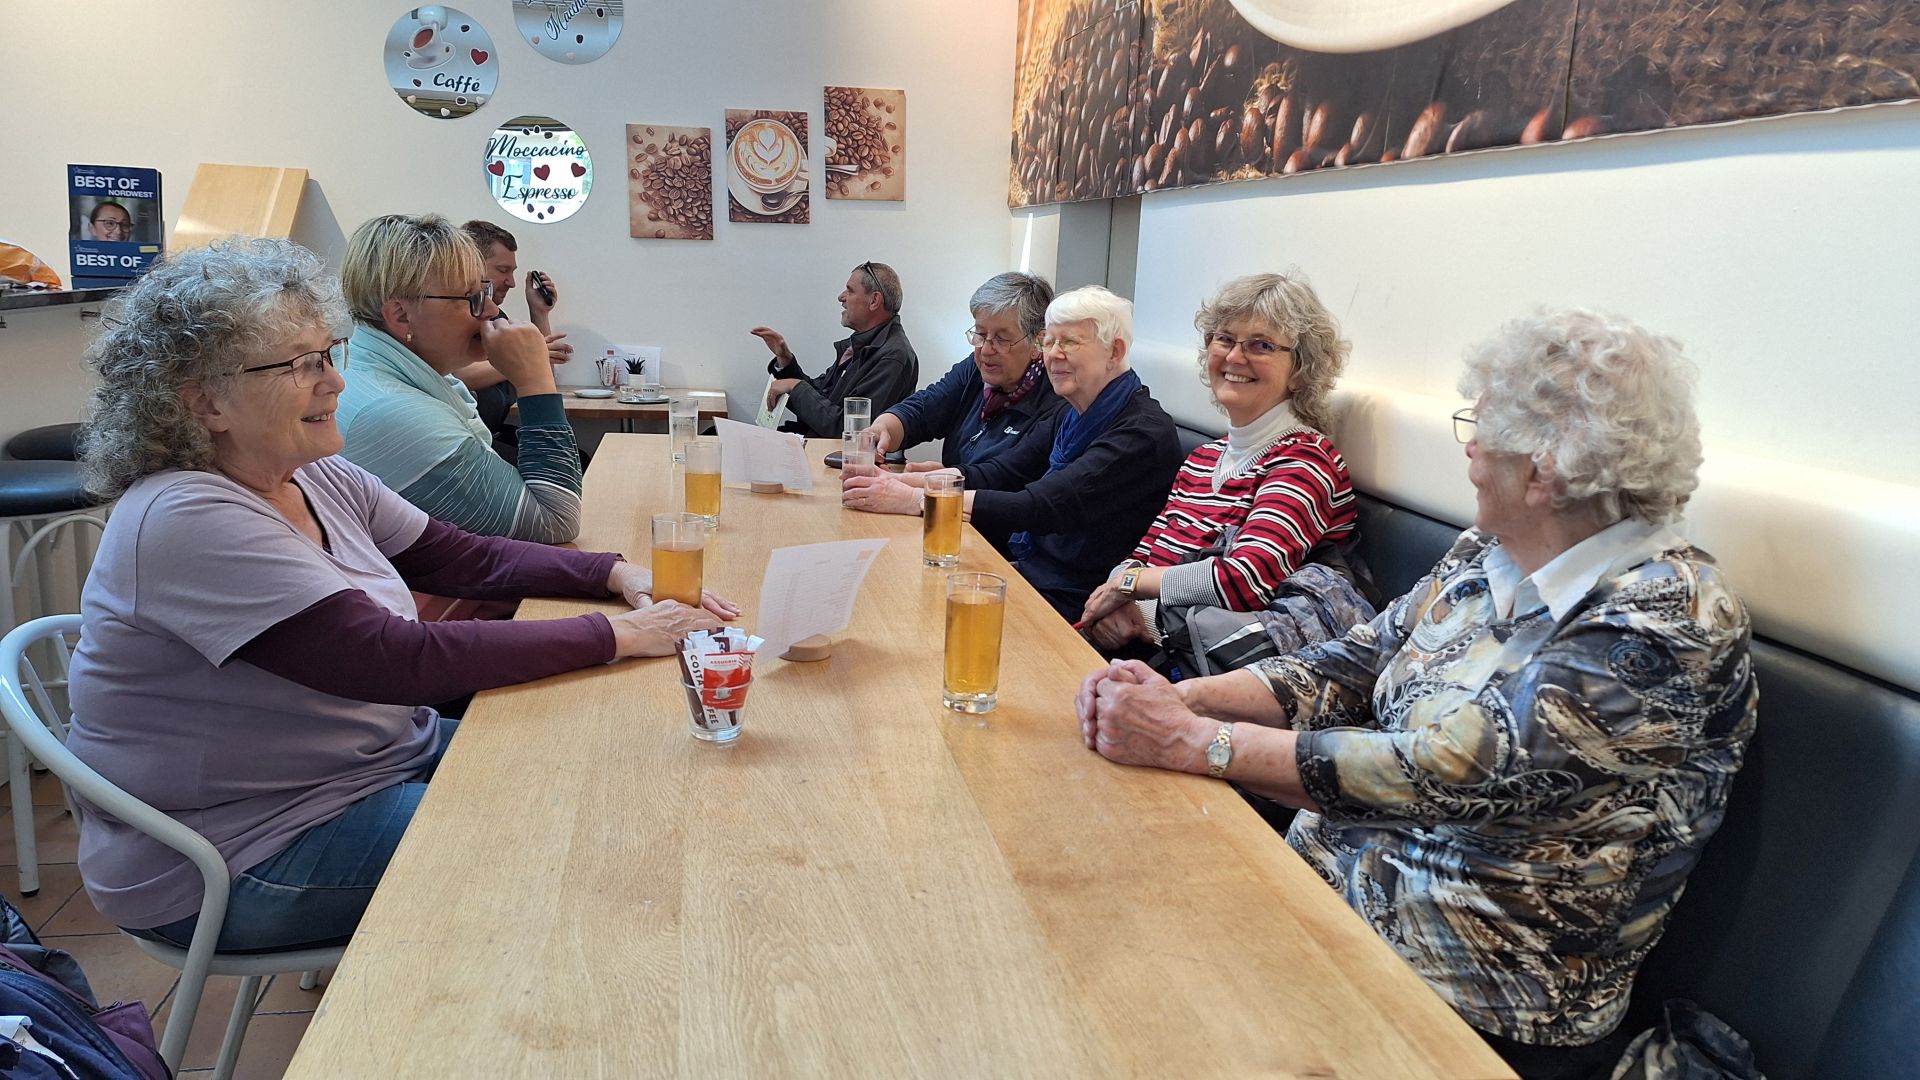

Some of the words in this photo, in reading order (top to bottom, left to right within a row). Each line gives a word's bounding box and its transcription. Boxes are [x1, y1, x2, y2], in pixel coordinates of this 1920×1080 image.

[486, 134, 587, 160] Moccacino
[74, 176, 115, 189] BEST
[117, 178, 140, 190] OF
[502, 174, 579, 205] Espresso
[108, 189, 154, 198] NORDWEST
[76, 254, 117, 267] BEST
[120, 256, 142, 268] OF
[690, 654, 704, 688] COSTA
